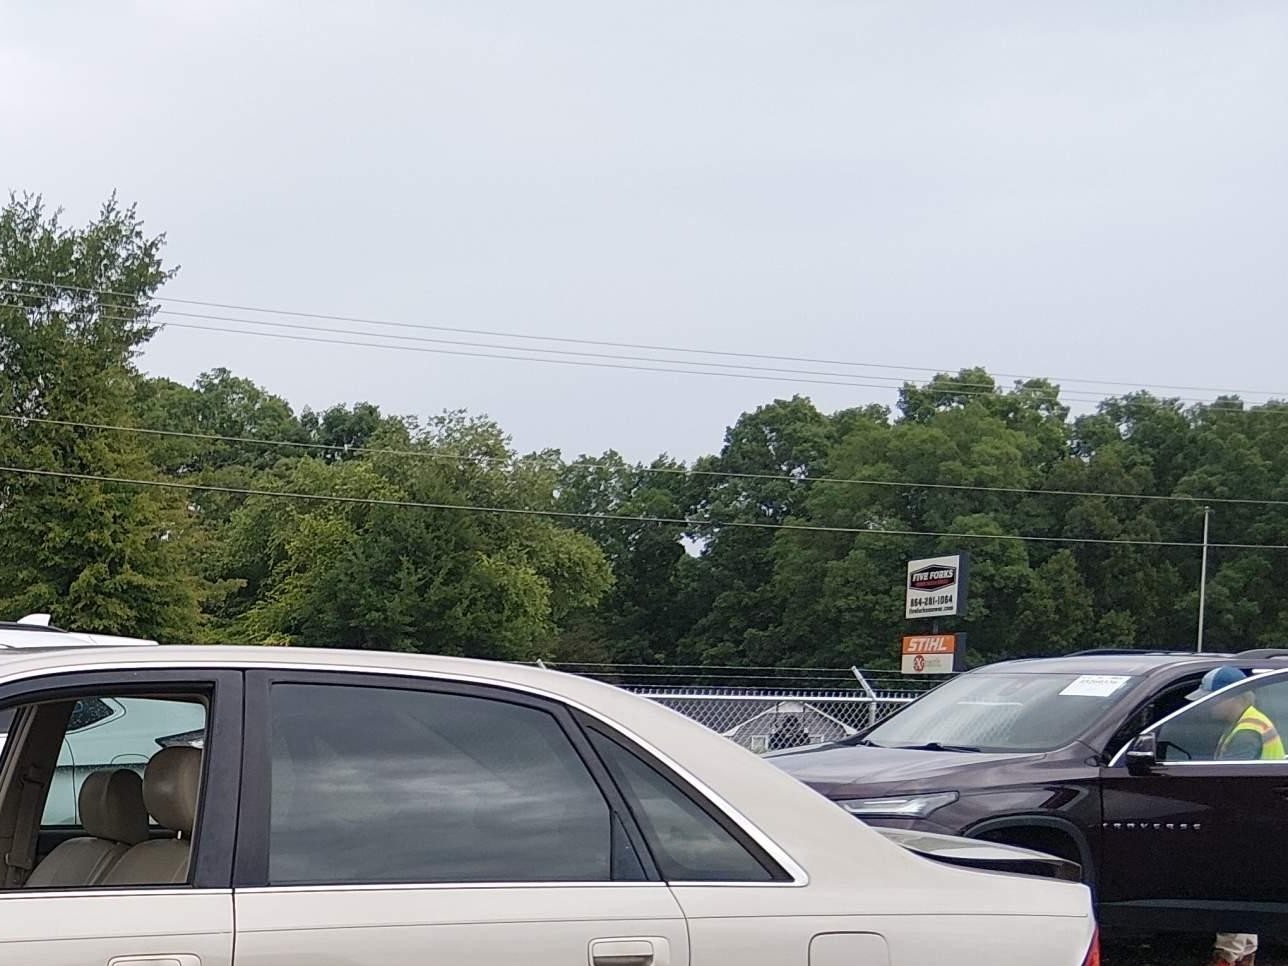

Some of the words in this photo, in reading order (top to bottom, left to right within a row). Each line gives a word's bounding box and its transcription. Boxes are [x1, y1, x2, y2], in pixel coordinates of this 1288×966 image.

[912, 571, 929, 582] FIVE
[929, 569, 954, 580] FORKS
[907, 637, 947, 652] STIHL
